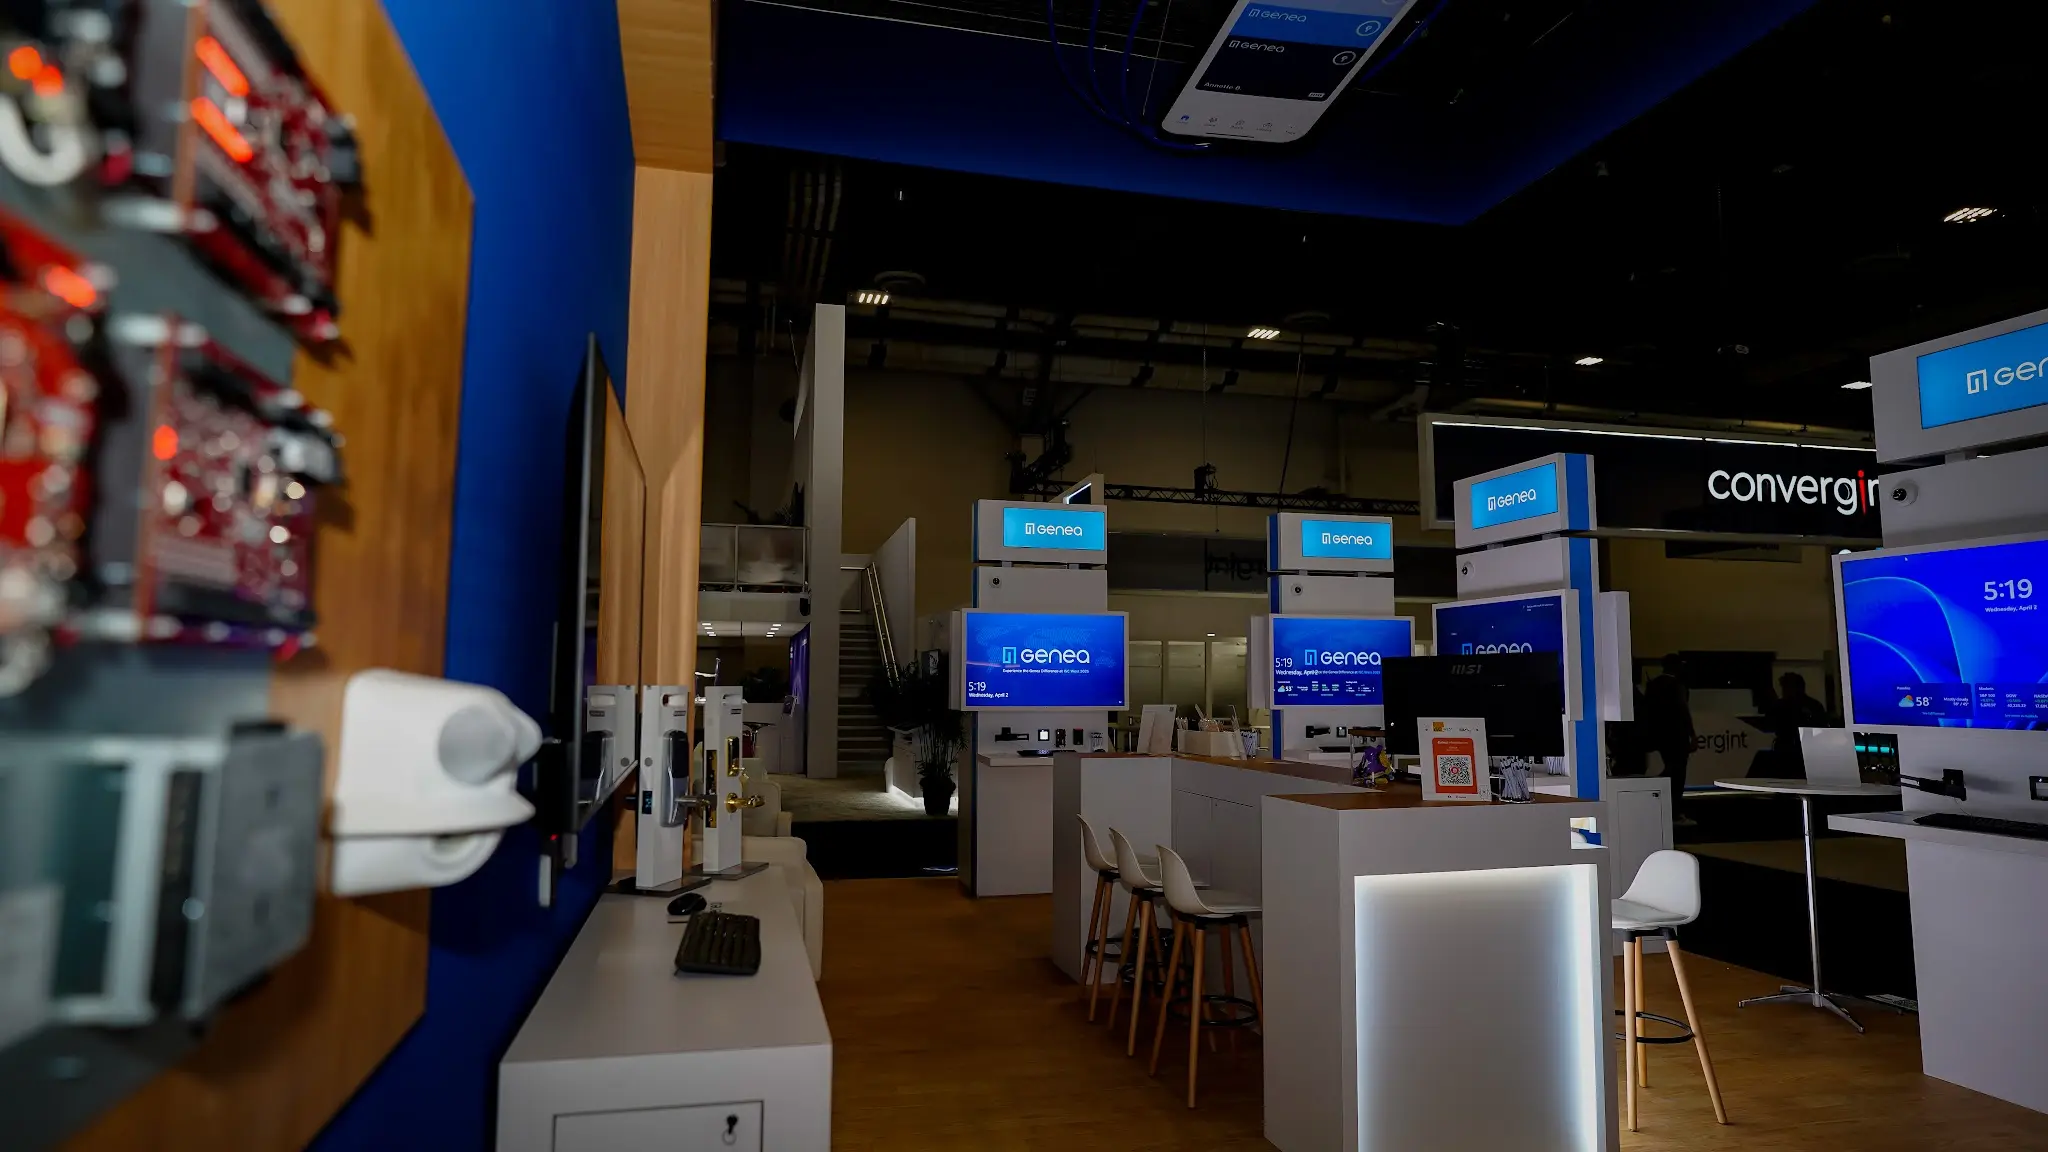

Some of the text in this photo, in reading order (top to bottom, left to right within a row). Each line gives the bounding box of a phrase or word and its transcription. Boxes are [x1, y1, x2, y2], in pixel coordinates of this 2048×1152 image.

[1497, 488, 1536, 508] Genea
[1037, 525, 1082, 536] Genea
[1333, 535, 1372, 545] Genea
[1984, 578, 2032, 600] 5:19
[1021, 649, 1090, 663] Genea
[1321, 651, 1381, 665] Genea
[1275, 658, 1292, 667] 5:19
[969, 682, 986, 691] 5:19
